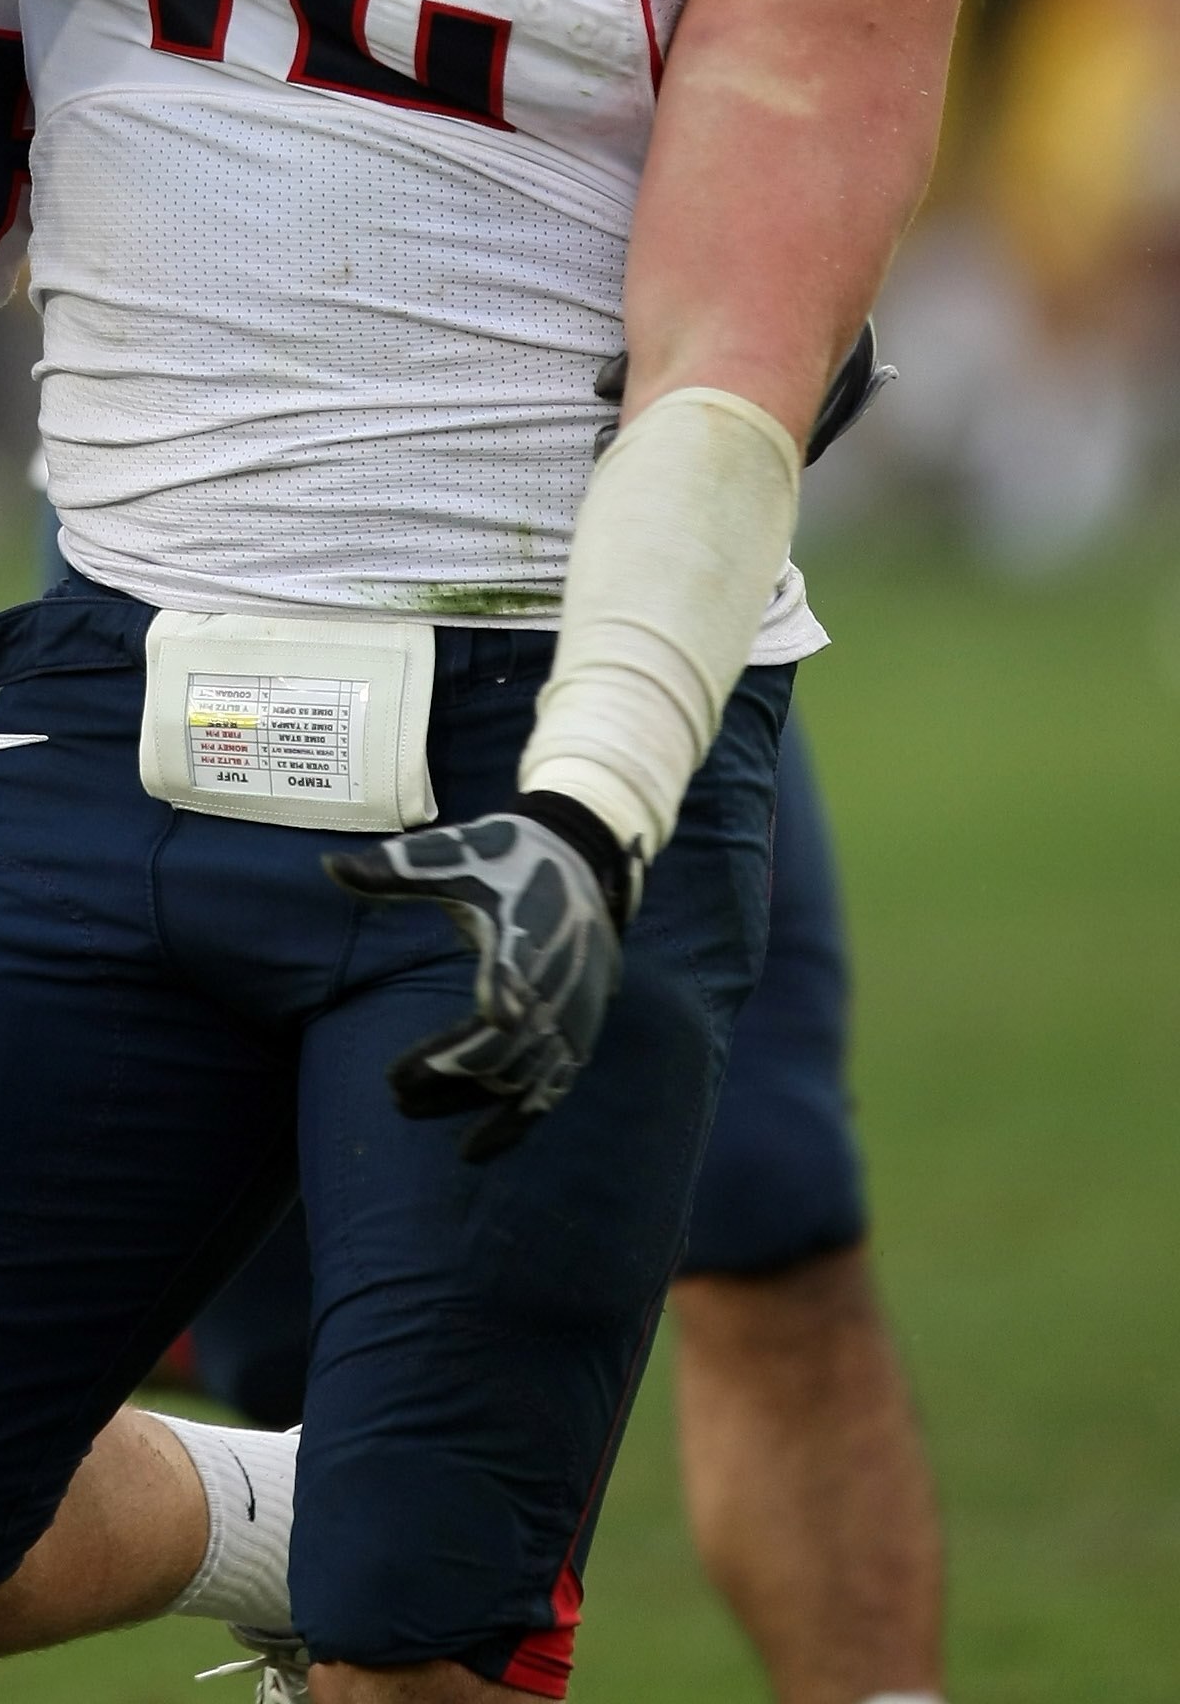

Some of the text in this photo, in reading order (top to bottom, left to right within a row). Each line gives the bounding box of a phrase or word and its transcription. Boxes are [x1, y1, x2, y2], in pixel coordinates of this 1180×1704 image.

[273, 706, 296, 715] OPEN
[311, 708, 334, 716] DIME
[271, 722, 300, 730] TAMPA
[311, 723, 334, 731] DIME
[222, 731, 242, 739] FIRE
[279, 734, 302, 742] STAR
[304, 735, 326, 744] DIME
[218, 744, 248, 753] MONEY
[217, 757, 242, 765] BLITZ
[306, 762, 330, 771] OVER
[216, 771, 249, 783] TUFF
[287, 776, 332, 789] TEMPO
